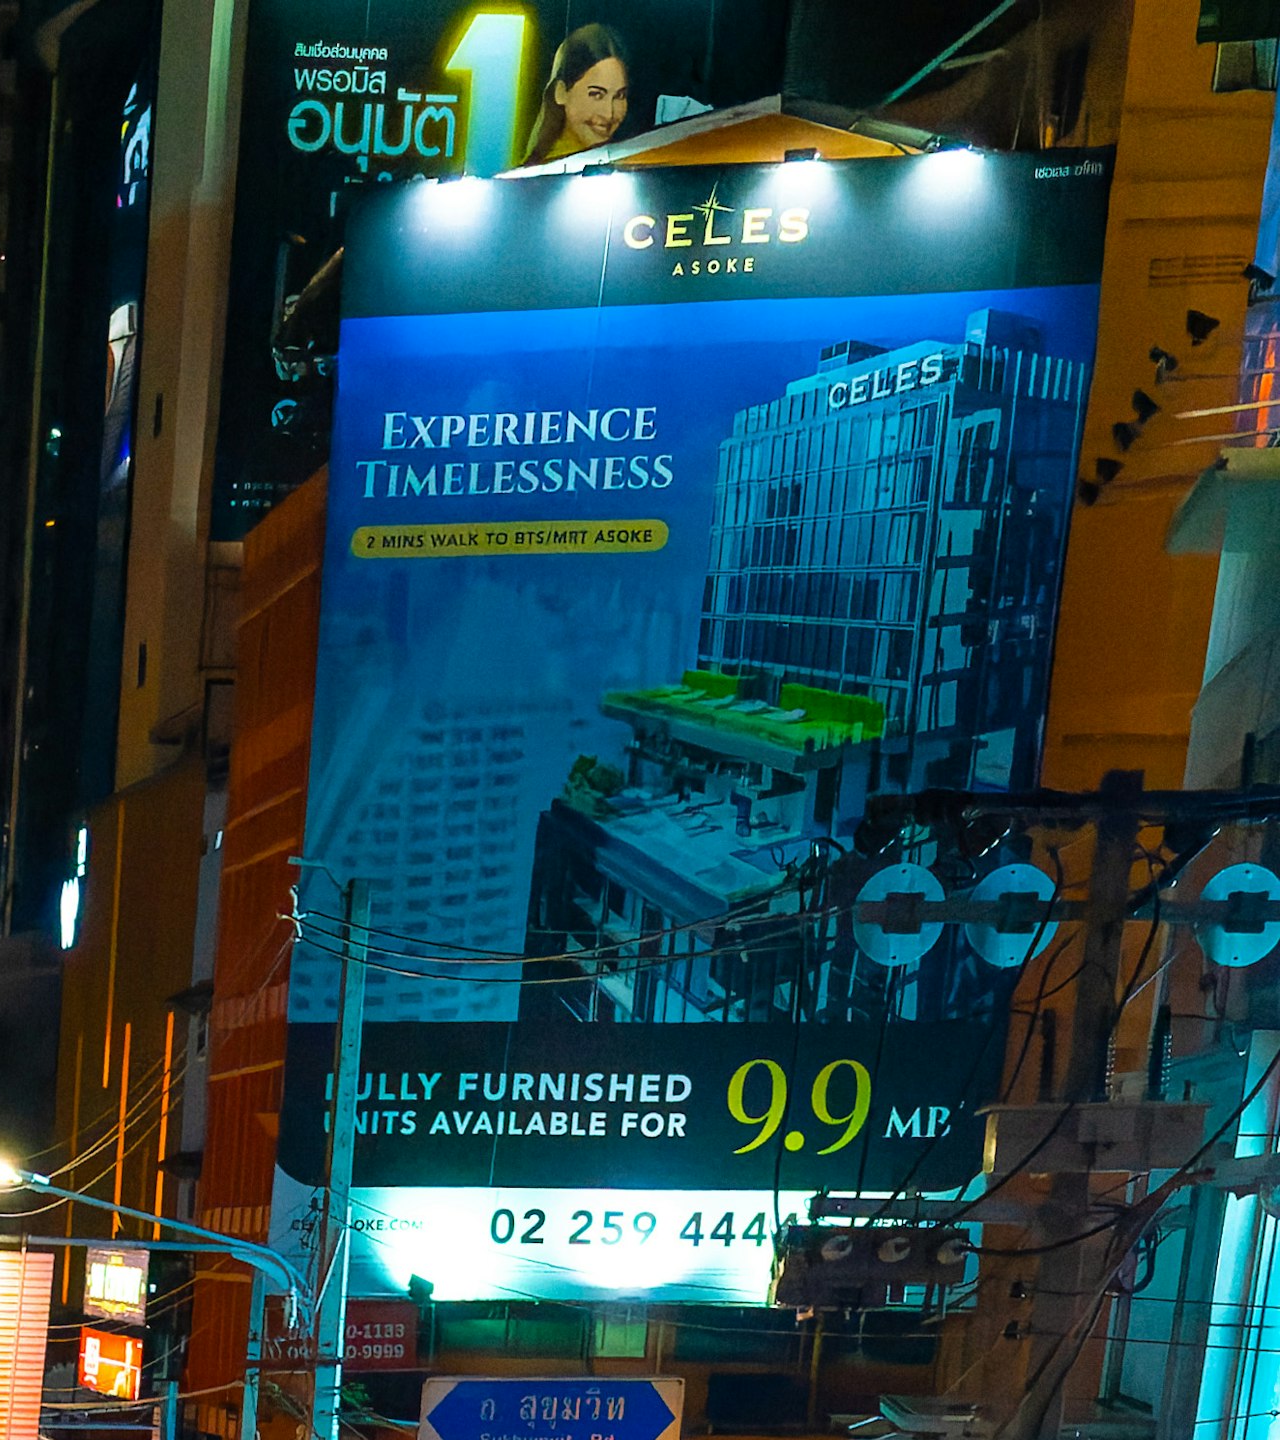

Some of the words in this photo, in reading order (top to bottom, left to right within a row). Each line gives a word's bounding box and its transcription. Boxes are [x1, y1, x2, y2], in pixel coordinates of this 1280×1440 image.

[294, 66, 386, 94] พรอมิส
[445, 13, 526, 178] 1
[288, 88, 458, 173] อนุมัติ
[623, 200, 811, 249] CELES
[672, 256, 755, 276] ASOKE
[828, 354, 944, 409] CELES
[382, 406, 658, 450] EXPERIENCE
[355, 454, 675, 498] TIMELESSNESS
[366, 536, 376, 549] 2
[382, 534, 424, 548] MINS
[431, 532, 479, 547] WALK
[486, 531, 509, 545] TO
[514, 529, 588, 545] BTS/MRT
[594, 528, 654, 544] ASOKE
[459, 1073, 692, 1103] FURNISHED
[727, 1059, 872, 1155] 9.9
[429, 1111, 607, 1137] AVAILABLE
[620, 1112, 687, 1137] FOR
[491, 1208, 544, 1244] 02
[569, 1210, 657, 1245] 259
[520, 1387, 625, 1430] สุขุมวิท
